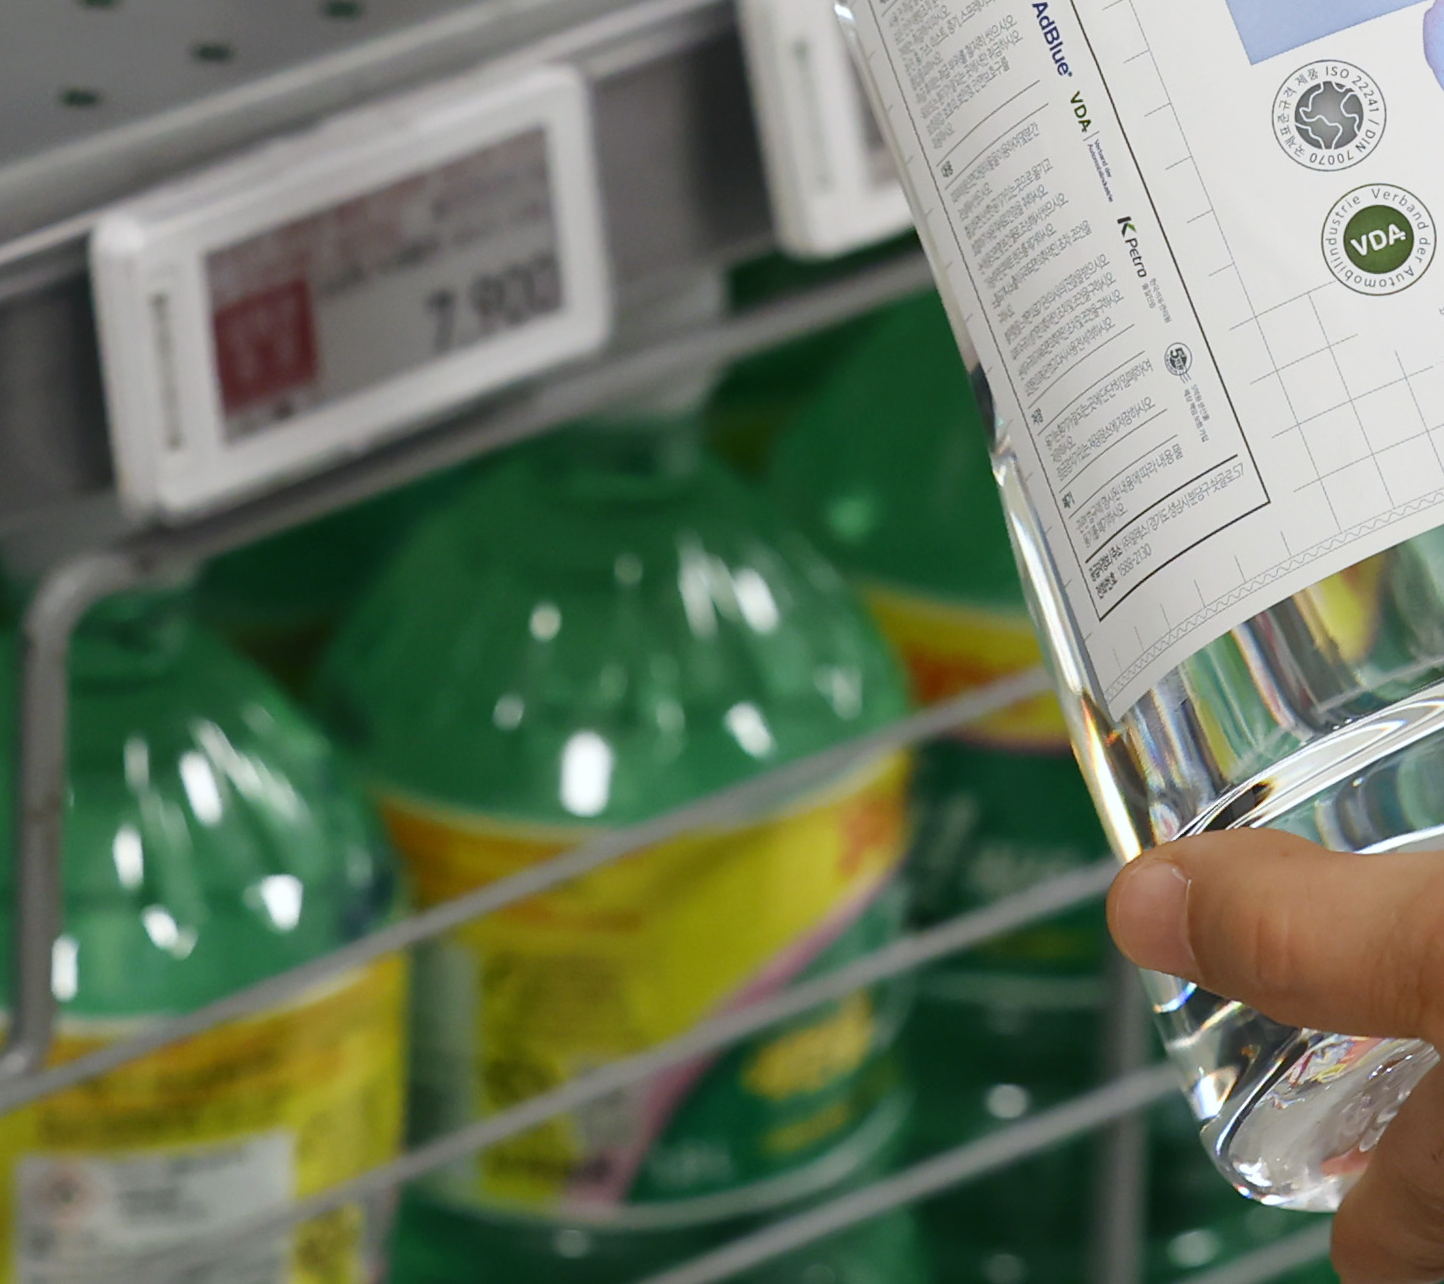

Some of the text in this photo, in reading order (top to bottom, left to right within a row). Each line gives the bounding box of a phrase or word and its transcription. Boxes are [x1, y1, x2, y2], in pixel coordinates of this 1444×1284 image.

[1325, 65, 1350, 79] ISO
[1070, 90, 1092, 133] VDA
[1352, 75, 1380, 113] 22241
[1355, 128, 1377, 153] DIN
[1324, 187, 1431, 289] Verband der Automobilindustrie
[1350, 223, 1407, 256] VDA
